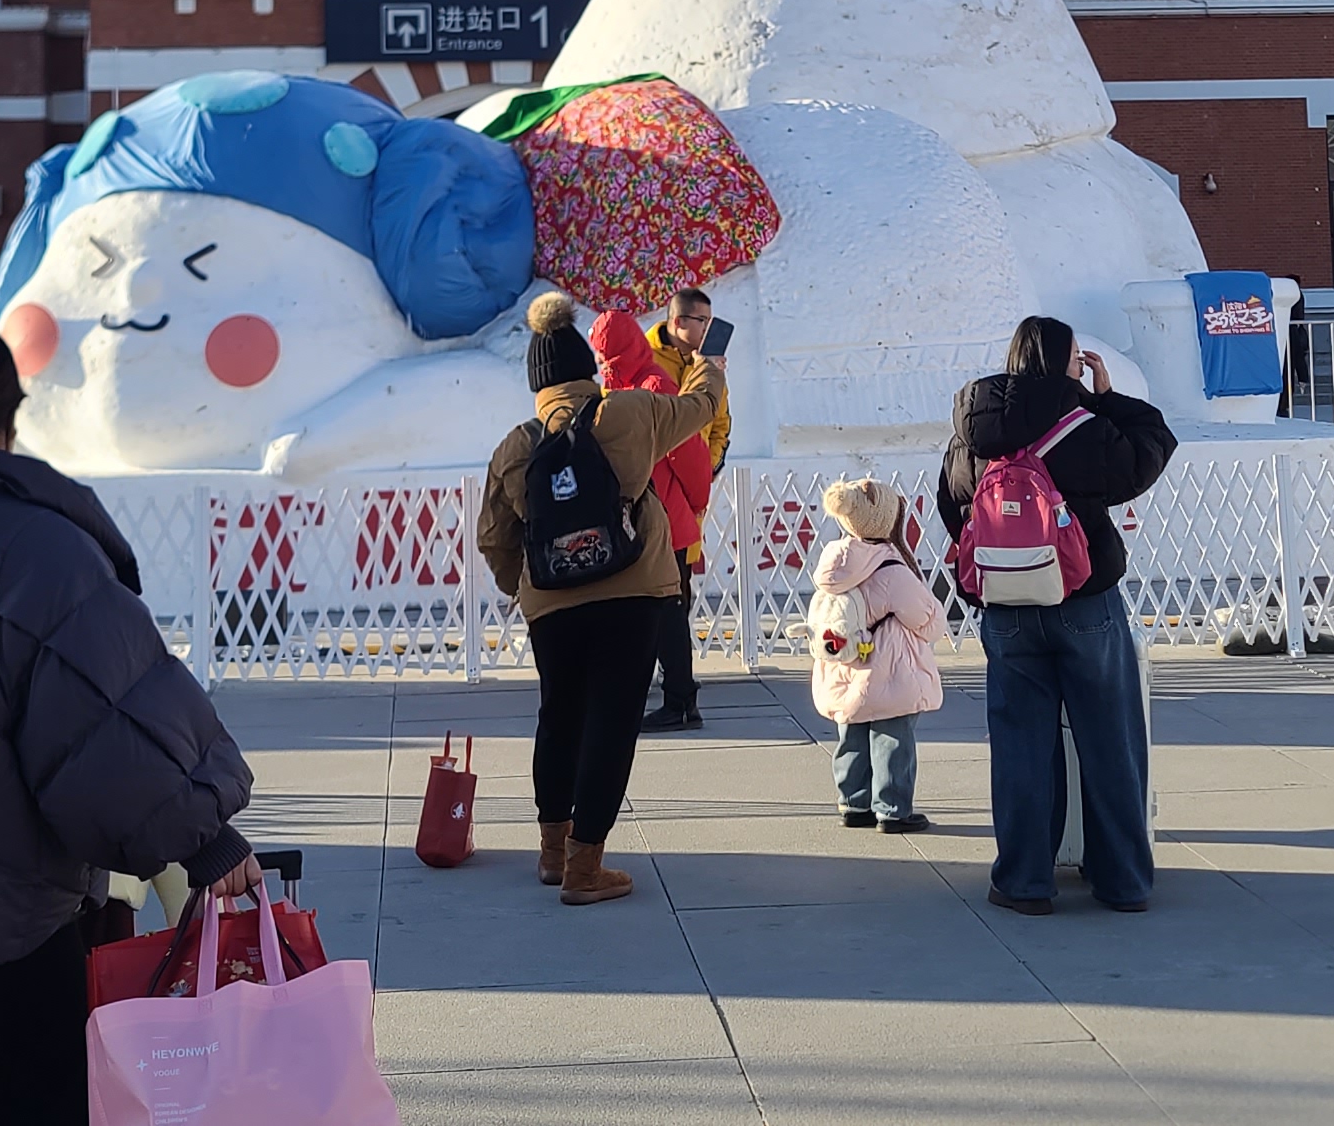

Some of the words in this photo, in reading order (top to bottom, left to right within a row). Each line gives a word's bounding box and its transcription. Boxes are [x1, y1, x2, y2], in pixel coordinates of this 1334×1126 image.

[436, 5, 521, 33] 进站口
[529, 5, 549, 49] 1
[436, 37, 503, 52] Entrance
[151, 1041, 219, 1059] HEYONWYE
